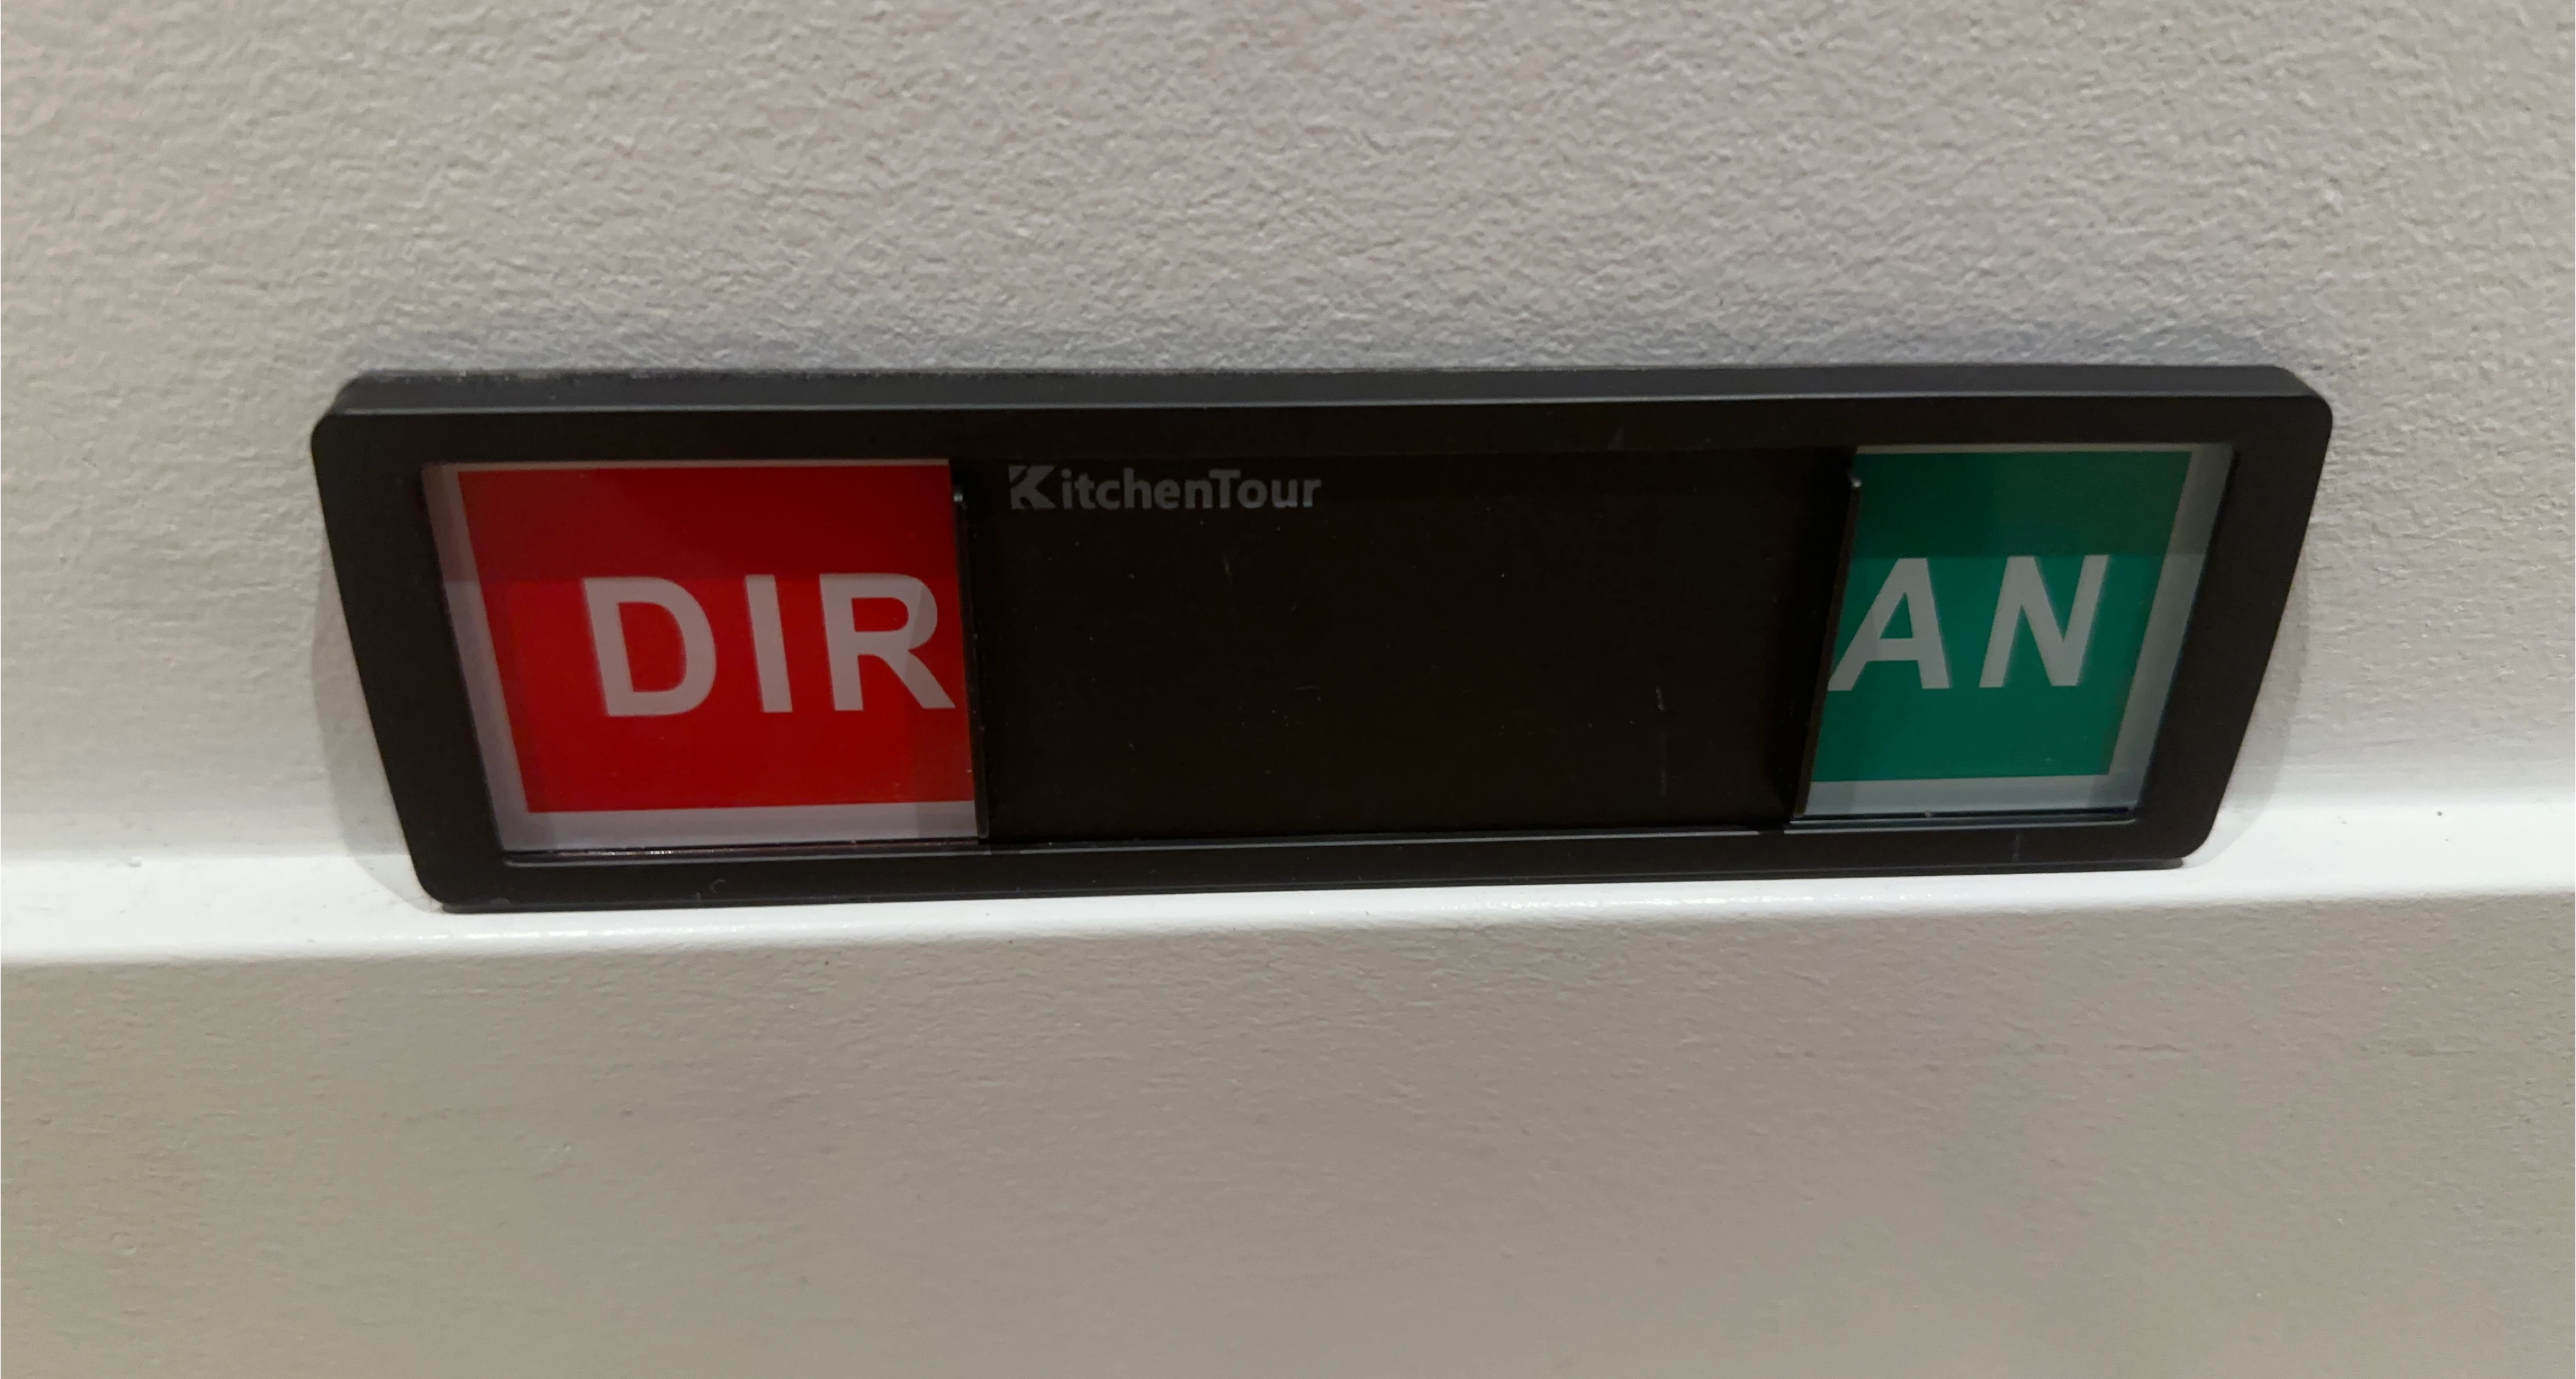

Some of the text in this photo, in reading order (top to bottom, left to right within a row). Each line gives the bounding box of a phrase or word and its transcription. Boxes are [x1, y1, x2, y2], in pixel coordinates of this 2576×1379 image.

[1008, 464, 1322, 510] KitchenTour
[583, 573, 955, 717] DIR
[1826, 554, 2110, 692] AN
